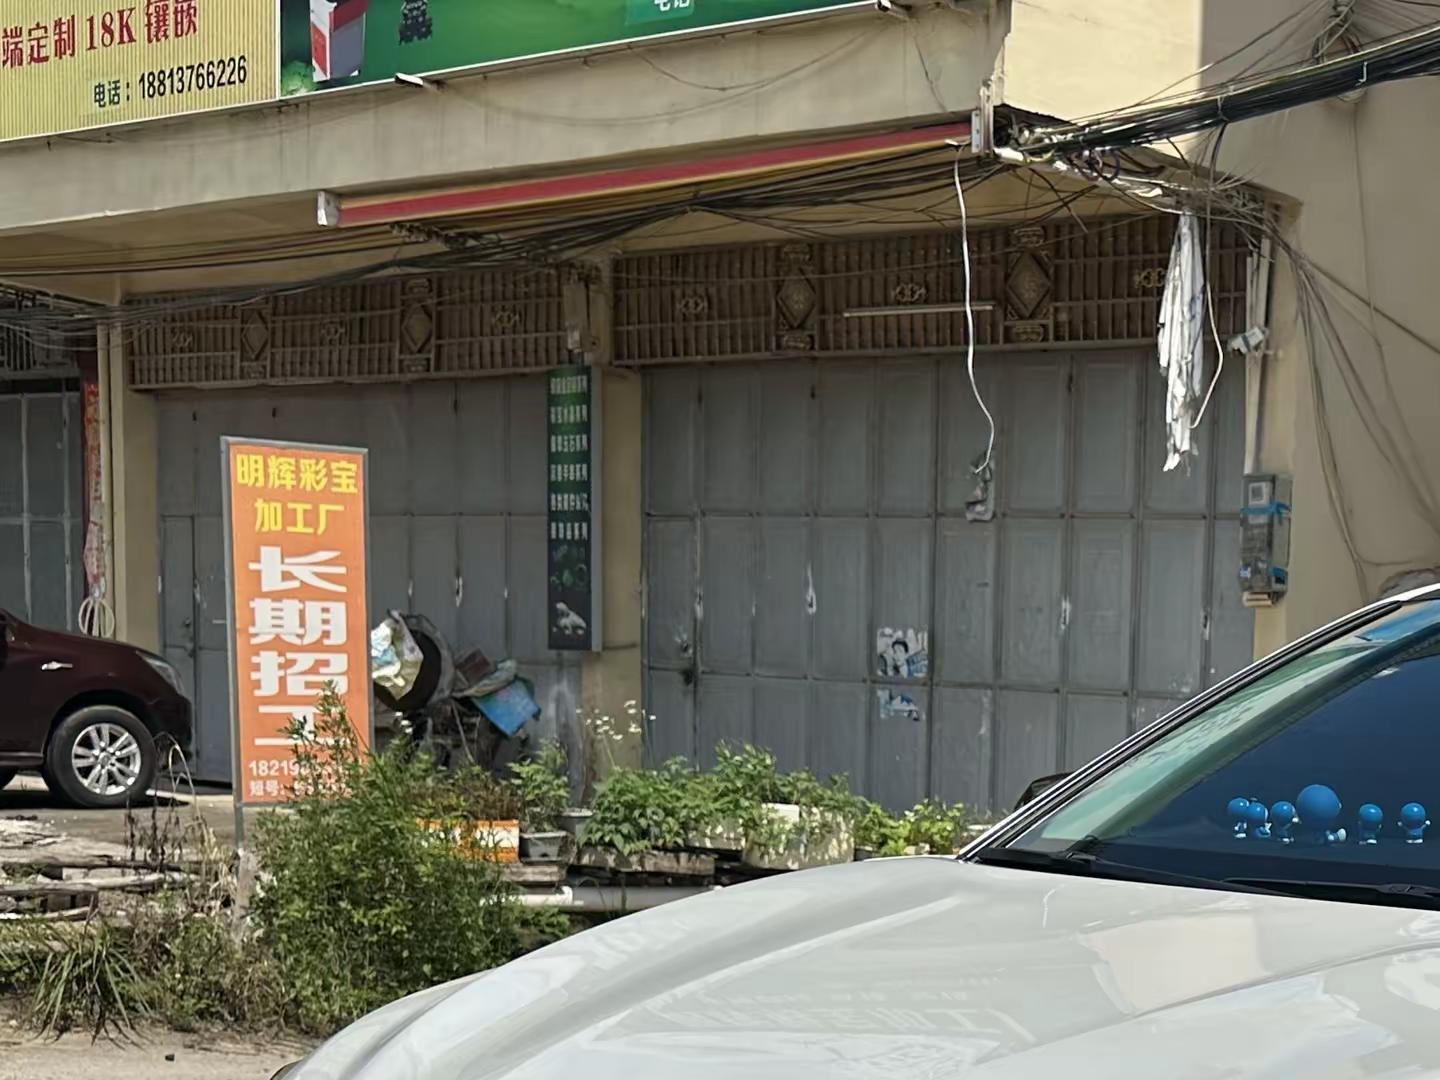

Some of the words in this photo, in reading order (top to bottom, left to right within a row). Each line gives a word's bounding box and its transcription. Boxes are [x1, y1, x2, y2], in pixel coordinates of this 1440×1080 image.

[2, 14, 76, 69] 端定制
[86, 7, 137, 51] 18K
[236, 454, 359, 495] 明辉彩宝
[254, 498, 345, 535] 加工厂
[248, 545, 349, 747] 长期招工
